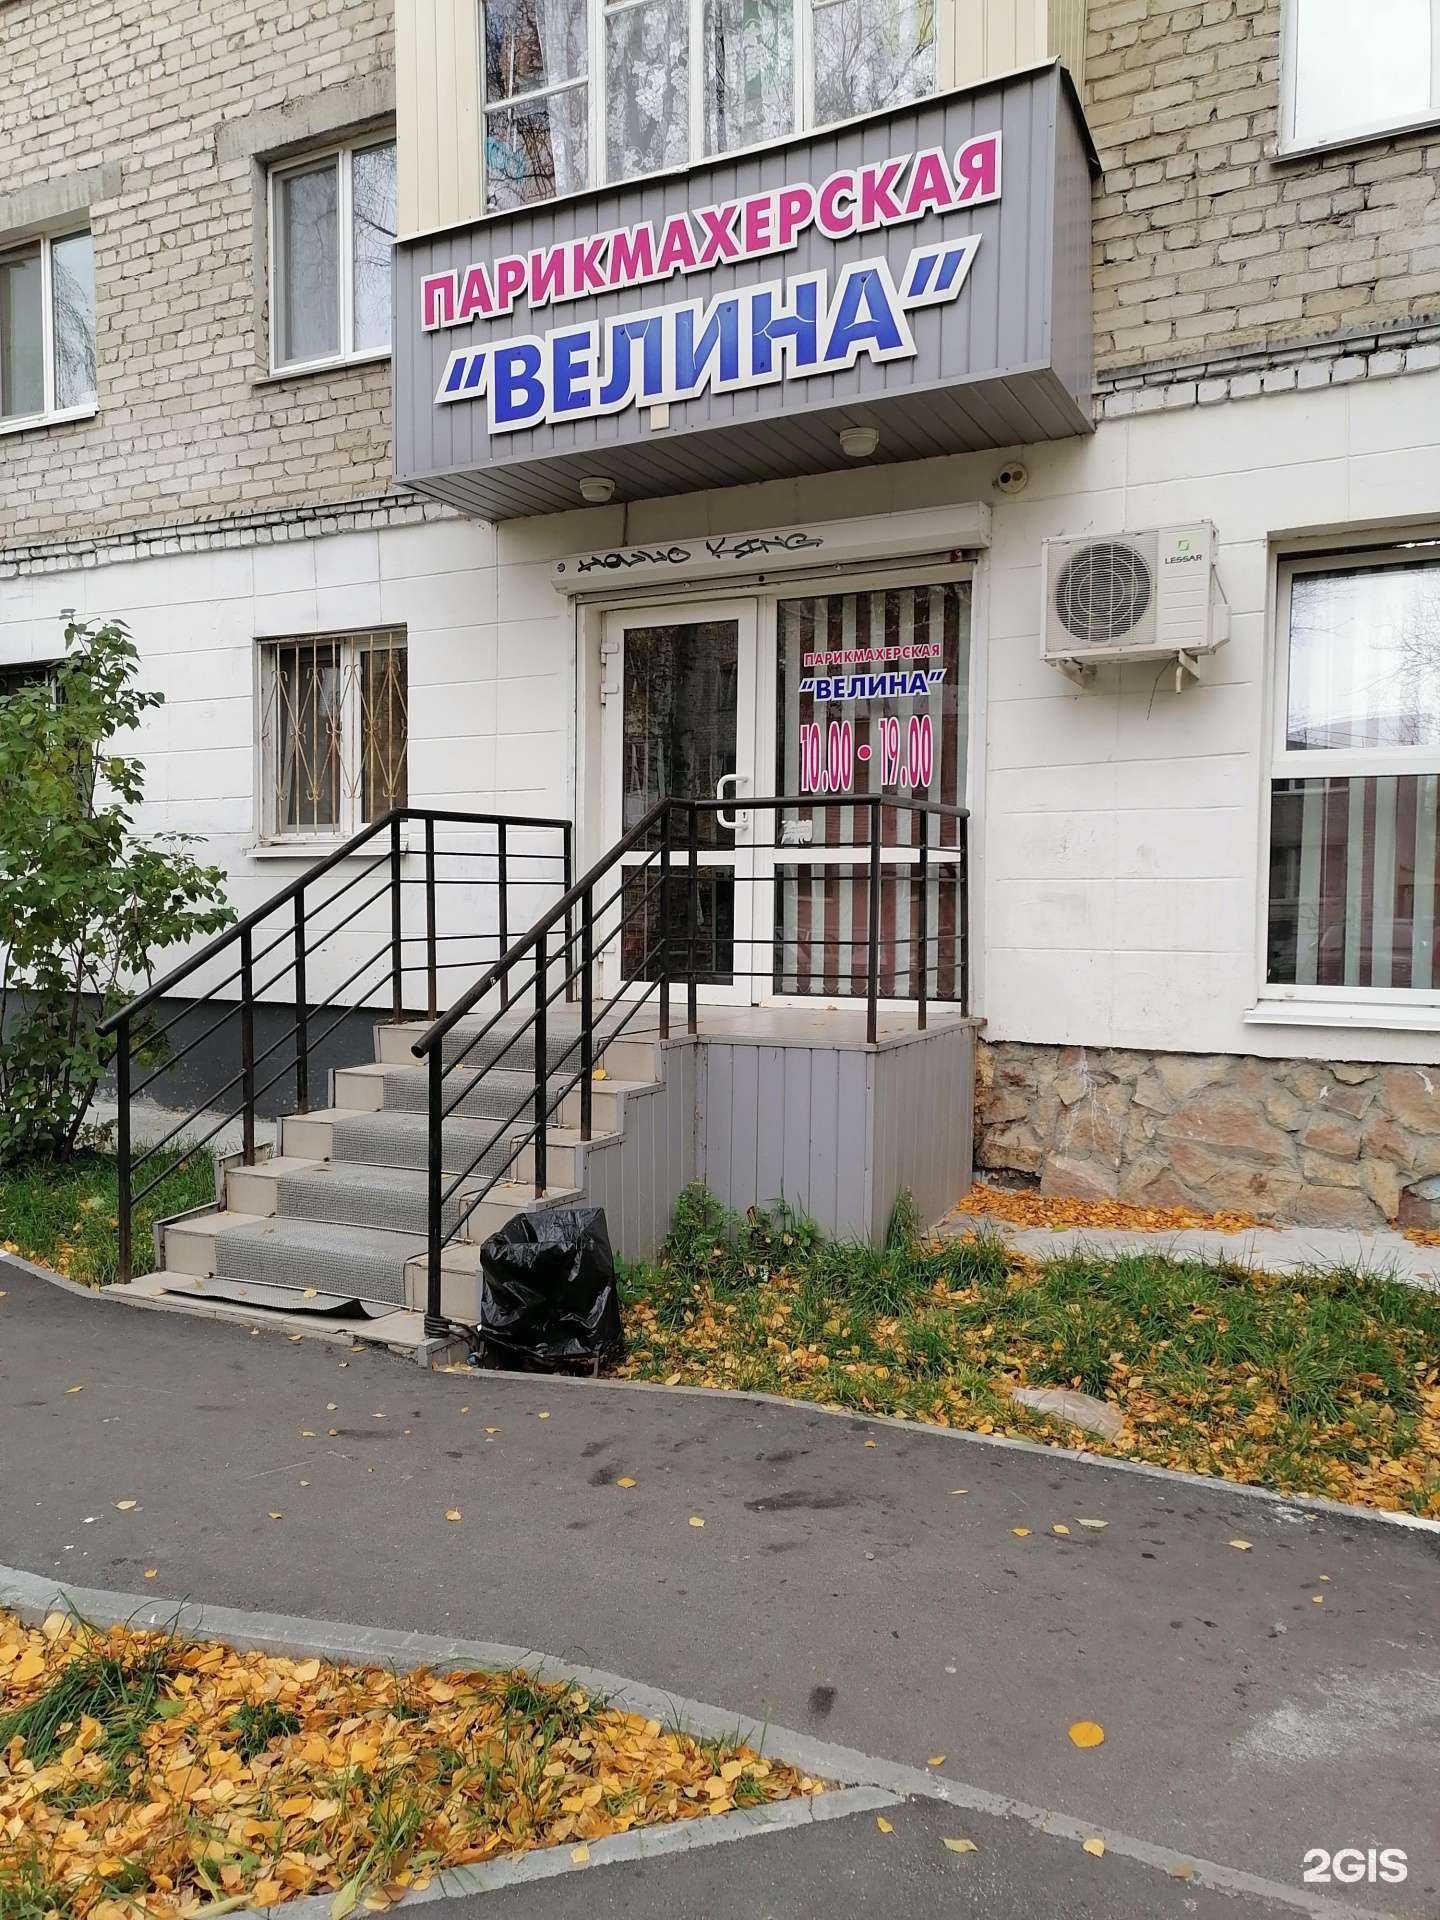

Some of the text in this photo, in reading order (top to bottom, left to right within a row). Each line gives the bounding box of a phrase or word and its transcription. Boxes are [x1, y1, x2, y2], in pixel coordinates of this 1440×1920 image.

[422, 132, 1001, 331] ПАРИКМАХЕРСКАЯ
[1164, 554, 1202, 565] LESSAR
[803, 643, 941, 667] ПАРИКМАХЕРСКАЯ
[800, 720, 853, 792] 10.00
[878, 714, 933, 787] 19.00
